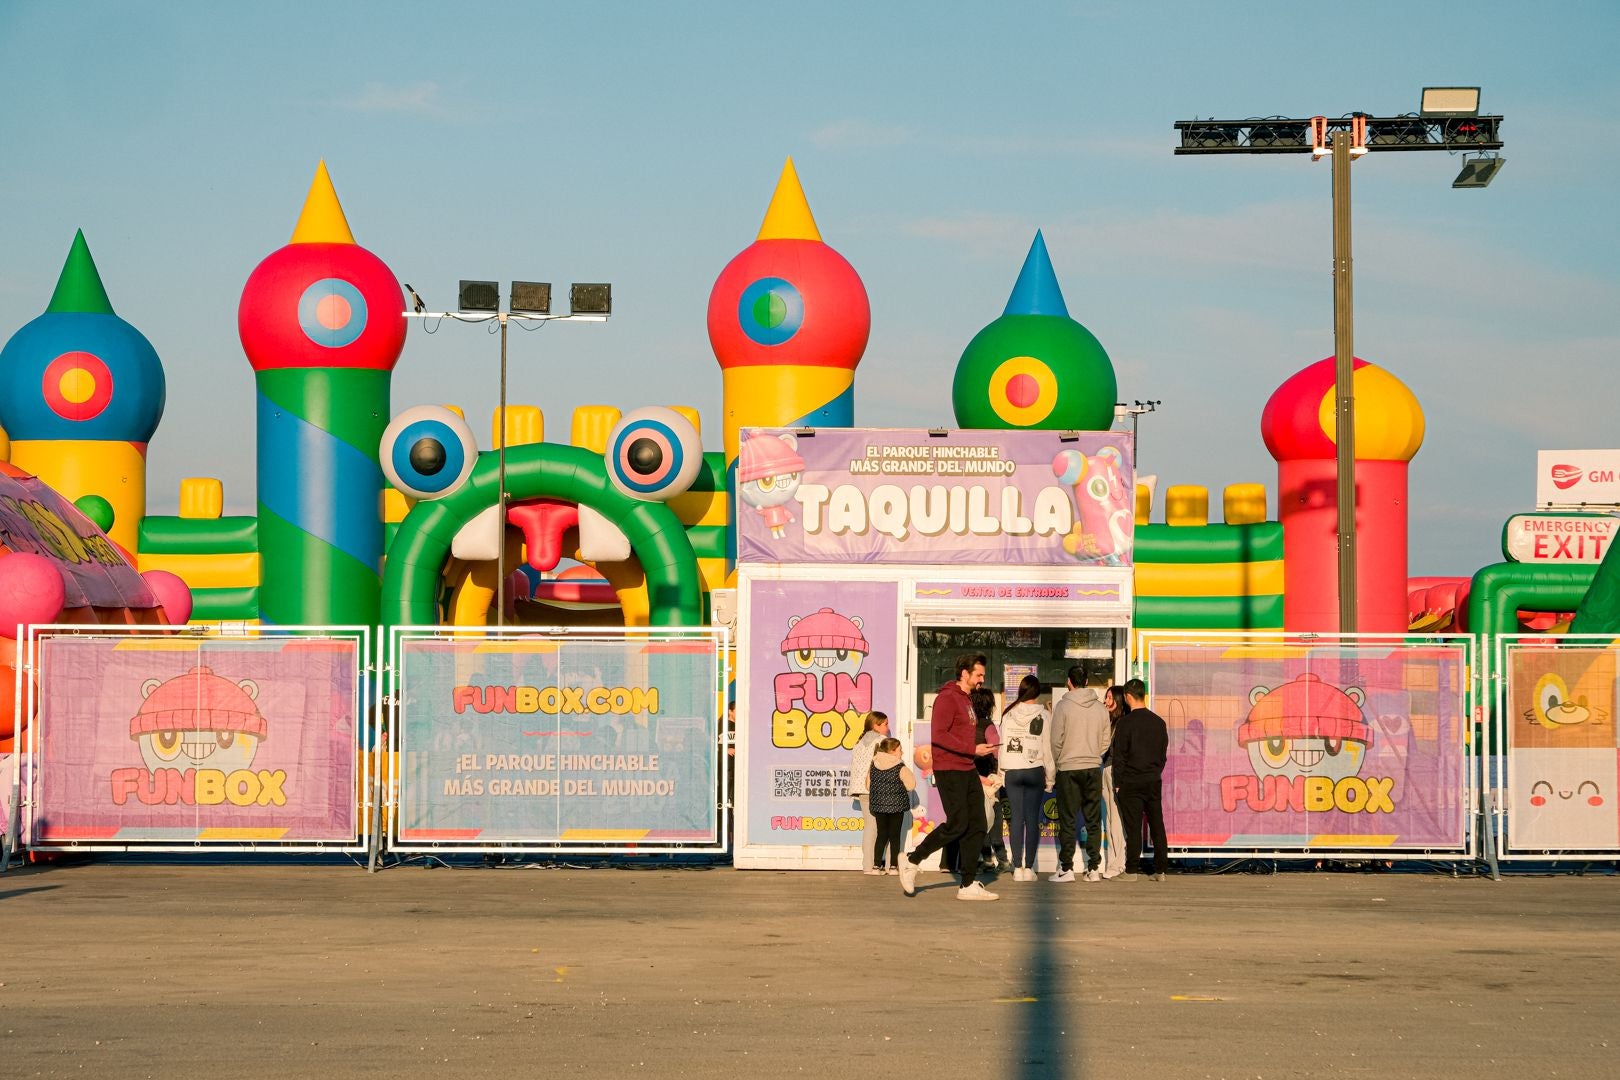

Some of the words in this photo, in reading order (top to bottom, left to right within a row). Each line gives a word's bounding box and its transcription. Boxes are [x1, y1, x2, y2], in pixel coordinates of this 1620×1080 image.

[866, 446, 881, 459] EL
[882, 446, 930, 460] PARQUE
[932, 446, 998, 459] HINCHABLE
[850, 457, 879, 474] MÁS
[881, 460, 937, 473] GRANDE
[938, 460, 963, 474] DEL
[964, 460, 1016, 474] MUNDO
[1589, 470, 1614, 483] GM
[795, 485, 1072, 540] TAQUILLA
[1524, 520, 1612, 533] EMERGENCY
[1533, 534, 1608, 560] EXIT
[961, 586, 995, 597] VENTA
[998, 587, 1012, 597] DE
[1015, 587, 1069, 598] ENTRADAS
[453, 686, 658, 714] FUNBOX.COM
[774, 672, 872, 713] FUN
[486, 754, 556, 773] PARQUE
[560, 754, 660, 772] HINCHABLE
[111, 768, 287, 806] FUNBOX
[443, 775, 484, 796] MÁS
[488, 779, 559, 796] GRANDE
[564, 779, 598, 796] DEL
[602, 779, 676, 797] MUNDO!
[805, 778, 822, 787] TUS
[1221, 775, 1395, 814] FUNBOX
